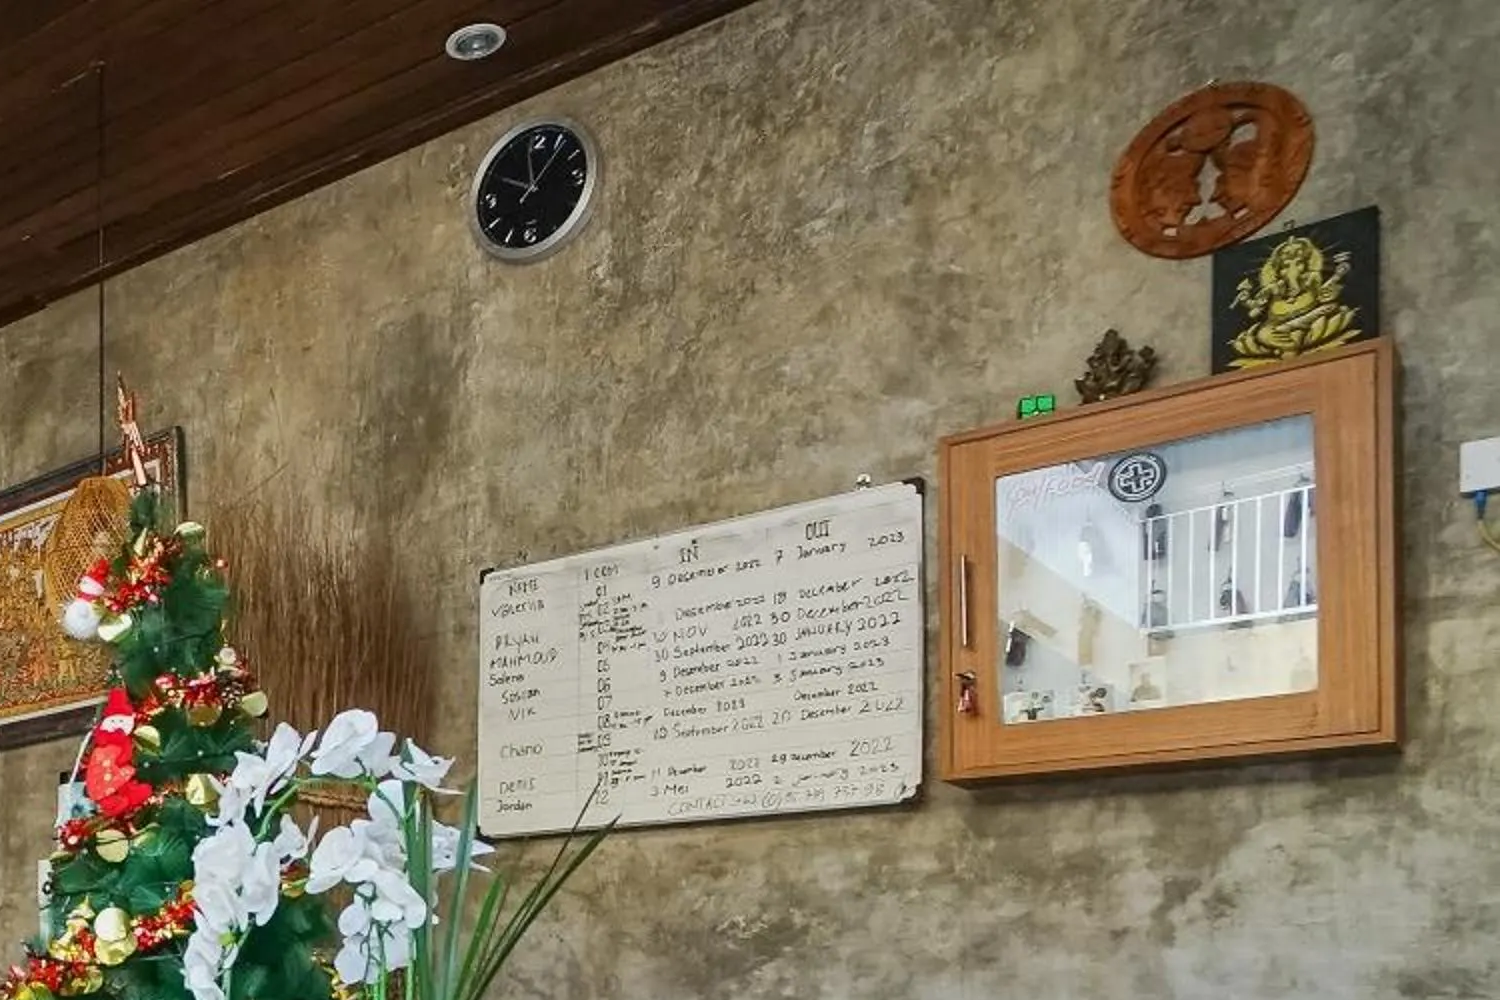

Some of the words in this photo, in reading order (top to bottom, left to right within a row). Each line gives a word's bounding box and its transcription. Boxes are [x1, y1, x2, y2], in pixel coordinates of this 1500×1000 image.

[679, 546, 699, 565] IN
[805, 519, 830, 541] OUT
[798, 543, 847, 561] January
[868, 531, 905, 547] 2023
[771, 610, 791, 626] 30
[857, 610, 901, 631] 2022
[850, 736, 895, 758] 2022
[725, 773, 763, 789] 2022
